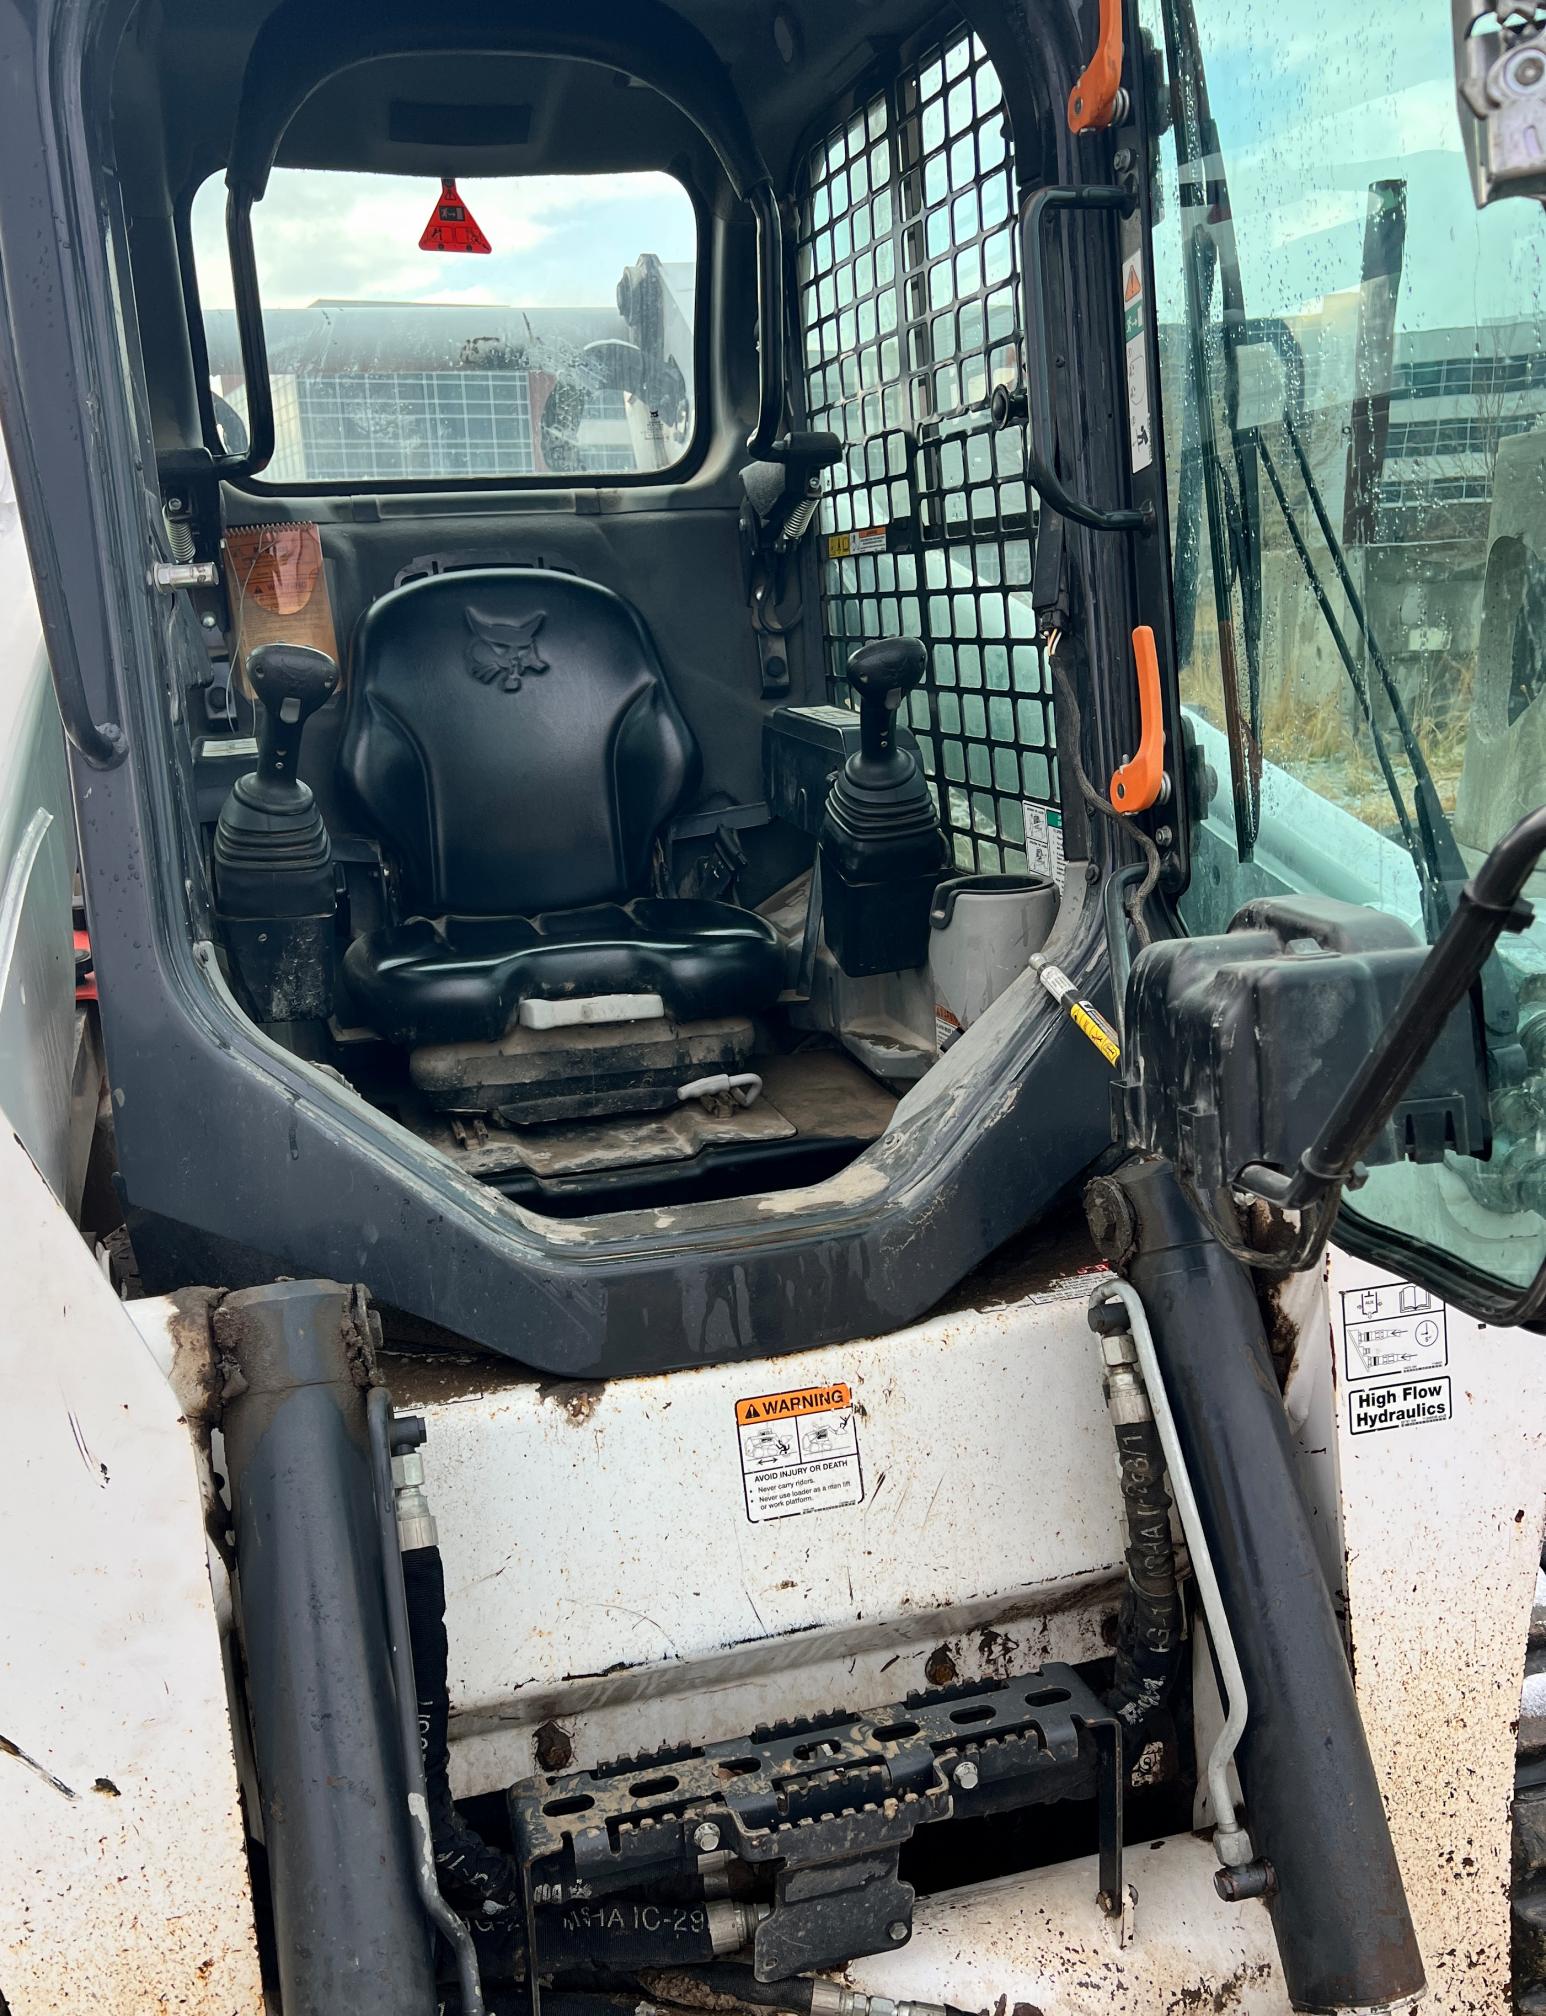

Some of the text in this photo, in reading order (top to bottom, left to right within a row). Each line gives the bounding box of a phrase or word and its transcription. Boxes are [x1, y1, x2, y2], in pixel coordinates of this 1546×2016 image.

[762, 1389, 843, 1415] WARNING
[1358, 1385, 1442, 1409] High Flow
[1356, 1402, 1446, 1428] Hydraulics
[754, 1460, 848, 1483] AVOID INJURY OR DEATH
[758, 1478, 815, 1493] Never carry riders.
[759, 1494, 778, 1503] Never
[791, 1487, 812, 1496] loader
[785, 1495, 813, 1506] platform.
